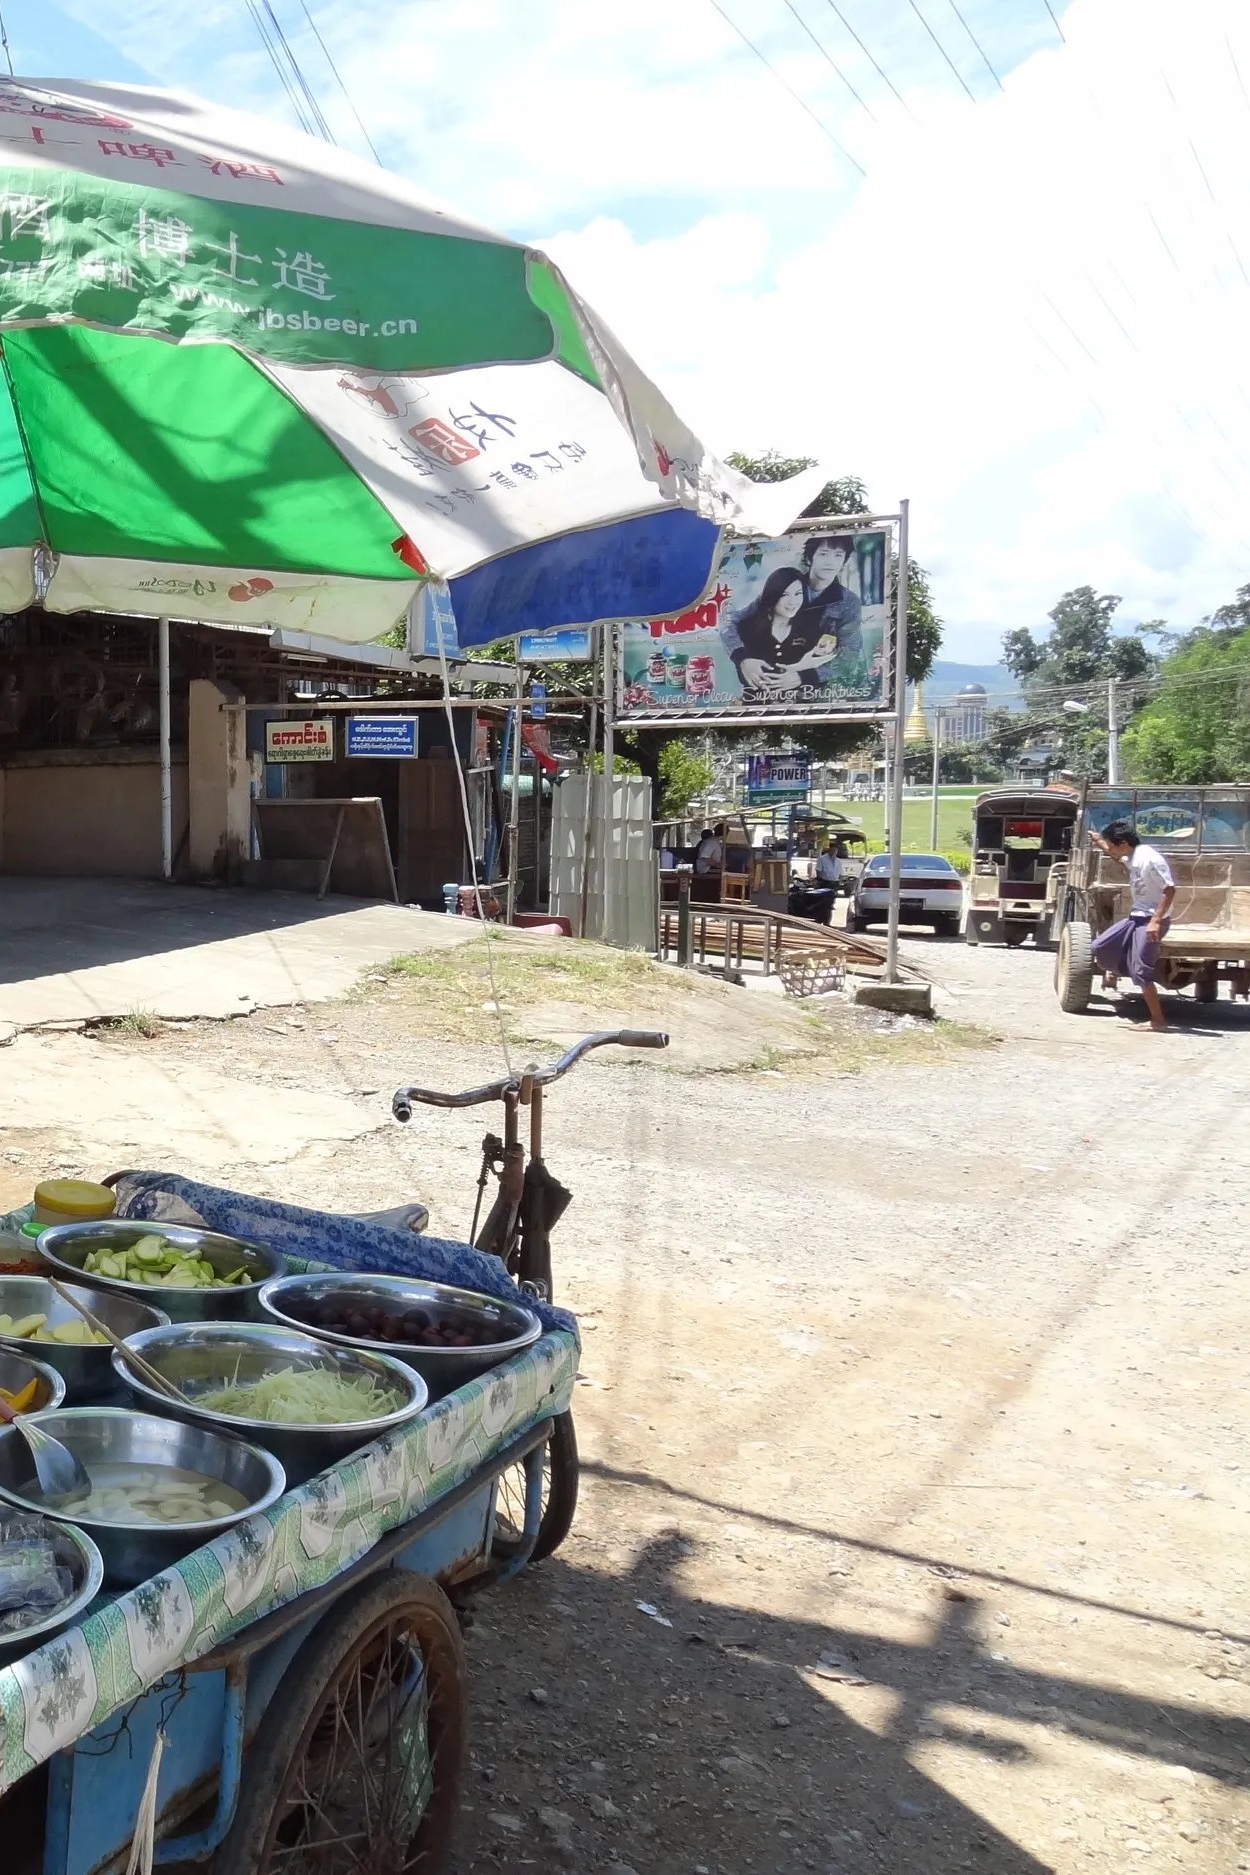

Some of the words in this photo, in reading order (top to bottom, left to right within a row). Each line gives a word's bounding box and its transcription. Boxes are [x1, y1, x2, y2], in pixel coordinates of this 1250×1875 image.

[131, 207, 337, 301] 博士造
[647, 690, 700, 708] Superior
[741, 686, 799, 705] Superior
[801, 684, 872, 704] Brightness
[771, 768, 807, 781] POWER
